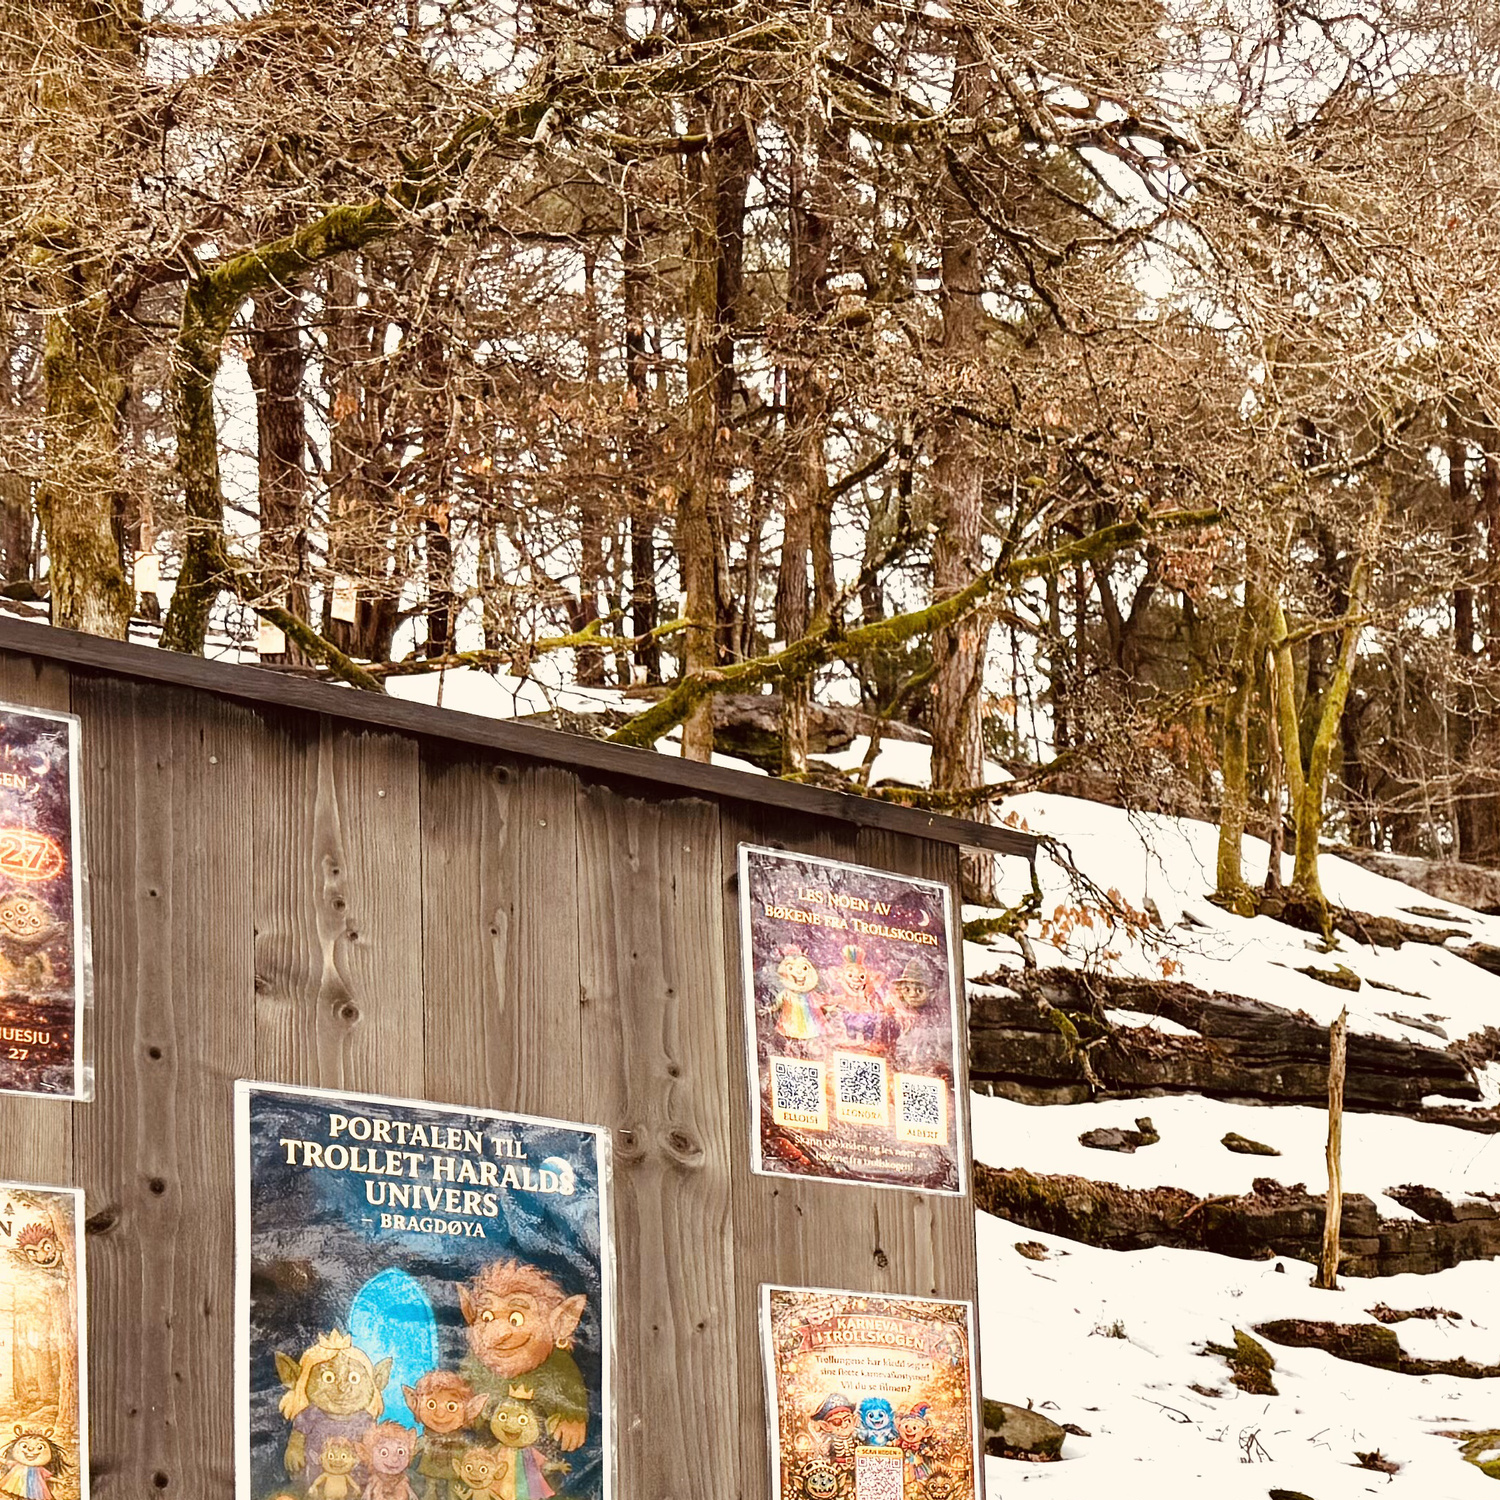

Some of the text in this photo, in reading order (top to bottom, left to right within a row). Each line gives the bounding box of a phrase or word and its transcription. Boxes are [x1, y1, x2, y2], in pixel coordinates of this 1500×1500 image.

[0, 772, 27, 790] EN
[0, 832, 48, 872] 27
[798, 888, 891, 916] LES NOEN AV
[765, 904, 939, 946] BØKENE FRA TROLLSKOGEN
[0, 1027, 50, 1045] UESJU
[8, 1048, 29, 1061] 27
[329, 1113, 527, 1160] PORTALEN TIL
[280, 1138, 575, 1196] TROLLET HARALDS
[365, 1180, 498, 1217] UNIVERS
[380, 1213, 486, 1238] BRAGDØYA
[837, 1317, 906, 1335] KARNEVAL
[823, 1330, 924, 1350] TROLLSKOGEN
